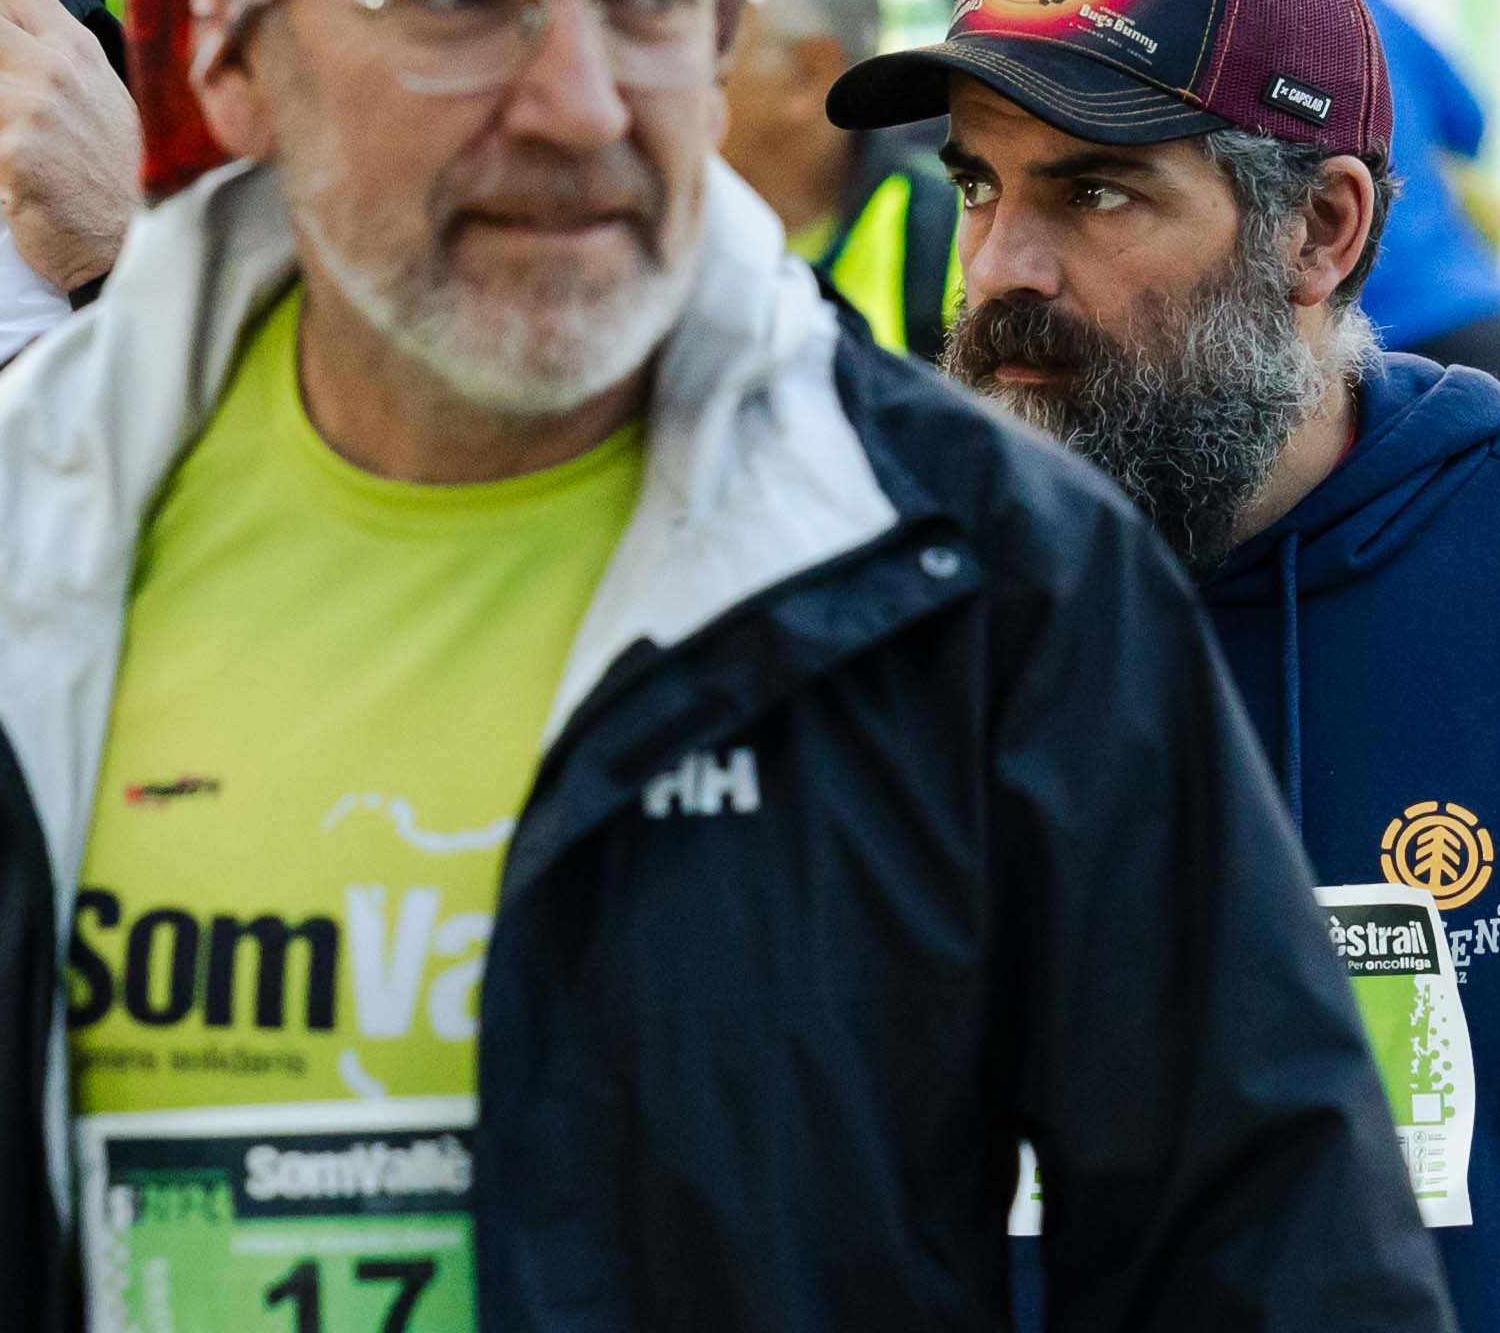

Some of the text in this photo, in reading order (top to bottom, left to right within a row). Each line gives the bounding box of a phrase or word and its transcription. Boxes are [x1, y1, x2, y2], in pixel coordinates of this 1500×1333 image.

[1079, 4, 1114, 28] Bugs
[1113, 19, 1159, 54] Bunny
[1365, 956, 1432, 971] oncolliga
